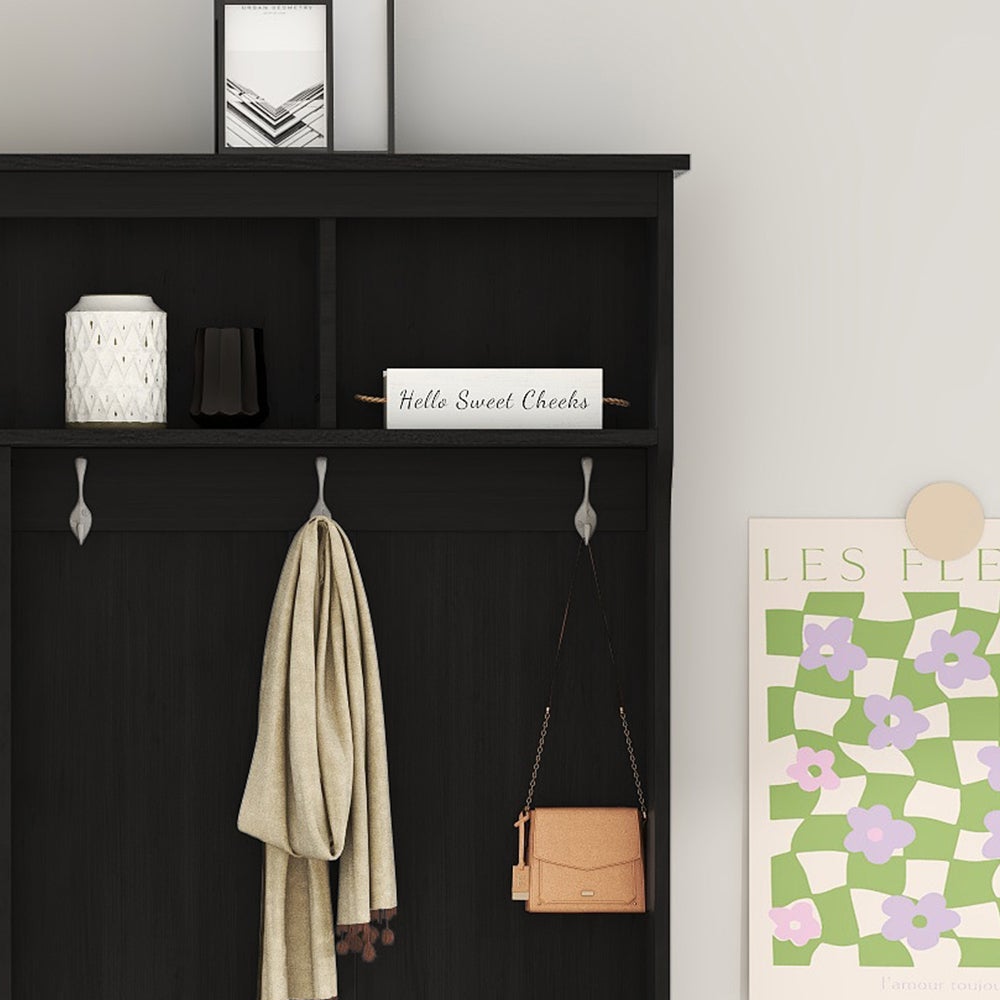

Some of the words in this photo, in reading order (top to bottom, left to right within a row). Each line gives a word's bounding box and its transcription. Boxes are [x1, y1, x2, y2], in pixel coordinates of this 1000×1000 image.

[399, 389, 448, 410] Hello
[455, 388, 514, 410] Sweet
[521, 388, 590, 410] Cheeks
[763, 547, 866, 582] LES
[881, 976, 943, 990] l'amour
